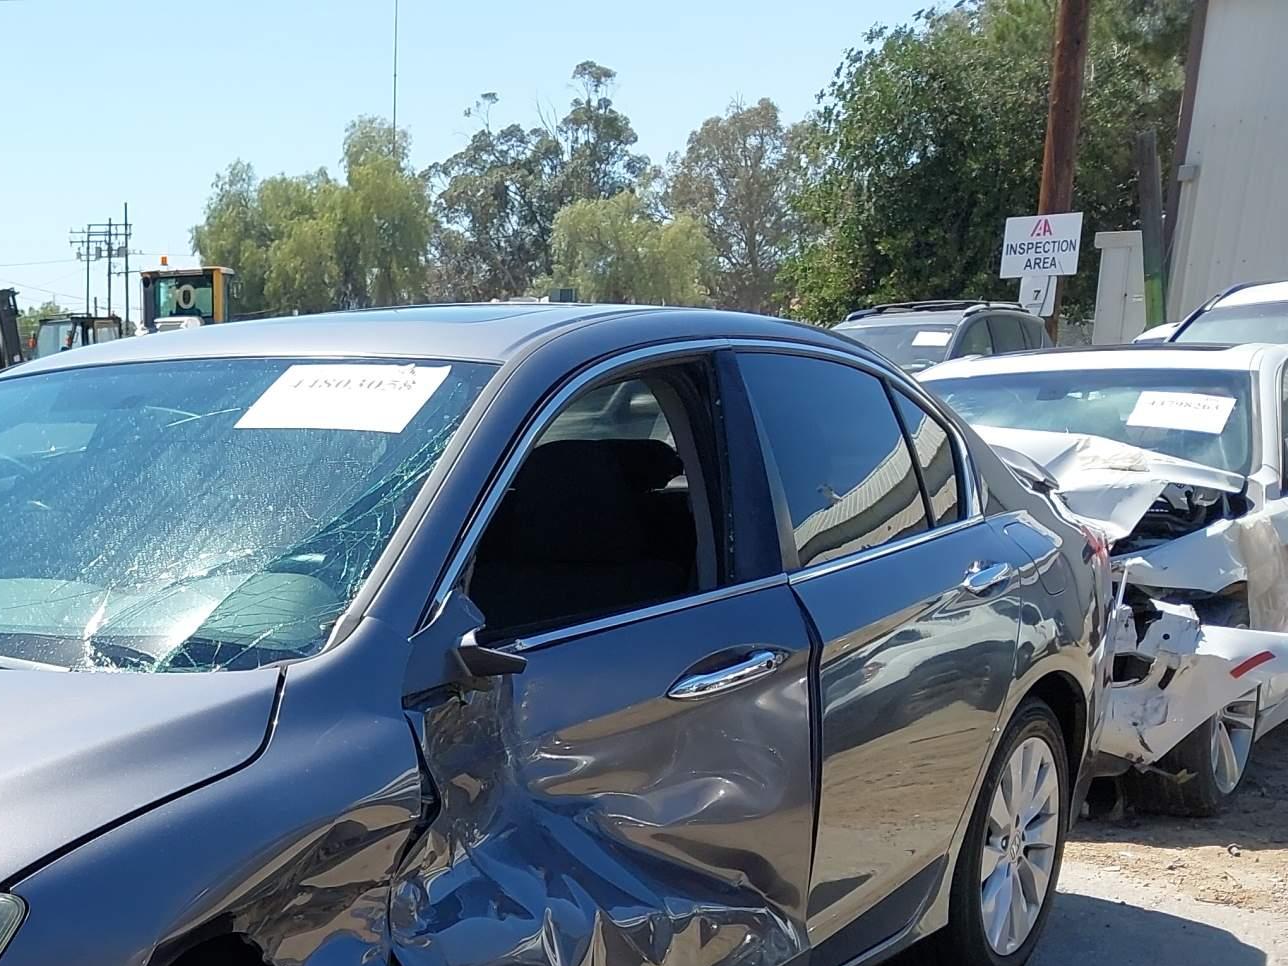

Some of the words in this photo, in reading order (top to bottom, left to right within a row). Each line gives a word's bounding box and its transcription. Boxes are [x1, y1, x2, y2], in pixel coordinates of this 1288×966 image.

[1005, 239, 1077, 256] INSPECTION
[1023, 256, 1057, 271] AREA
[1032, 289, 1042, 301] 7
